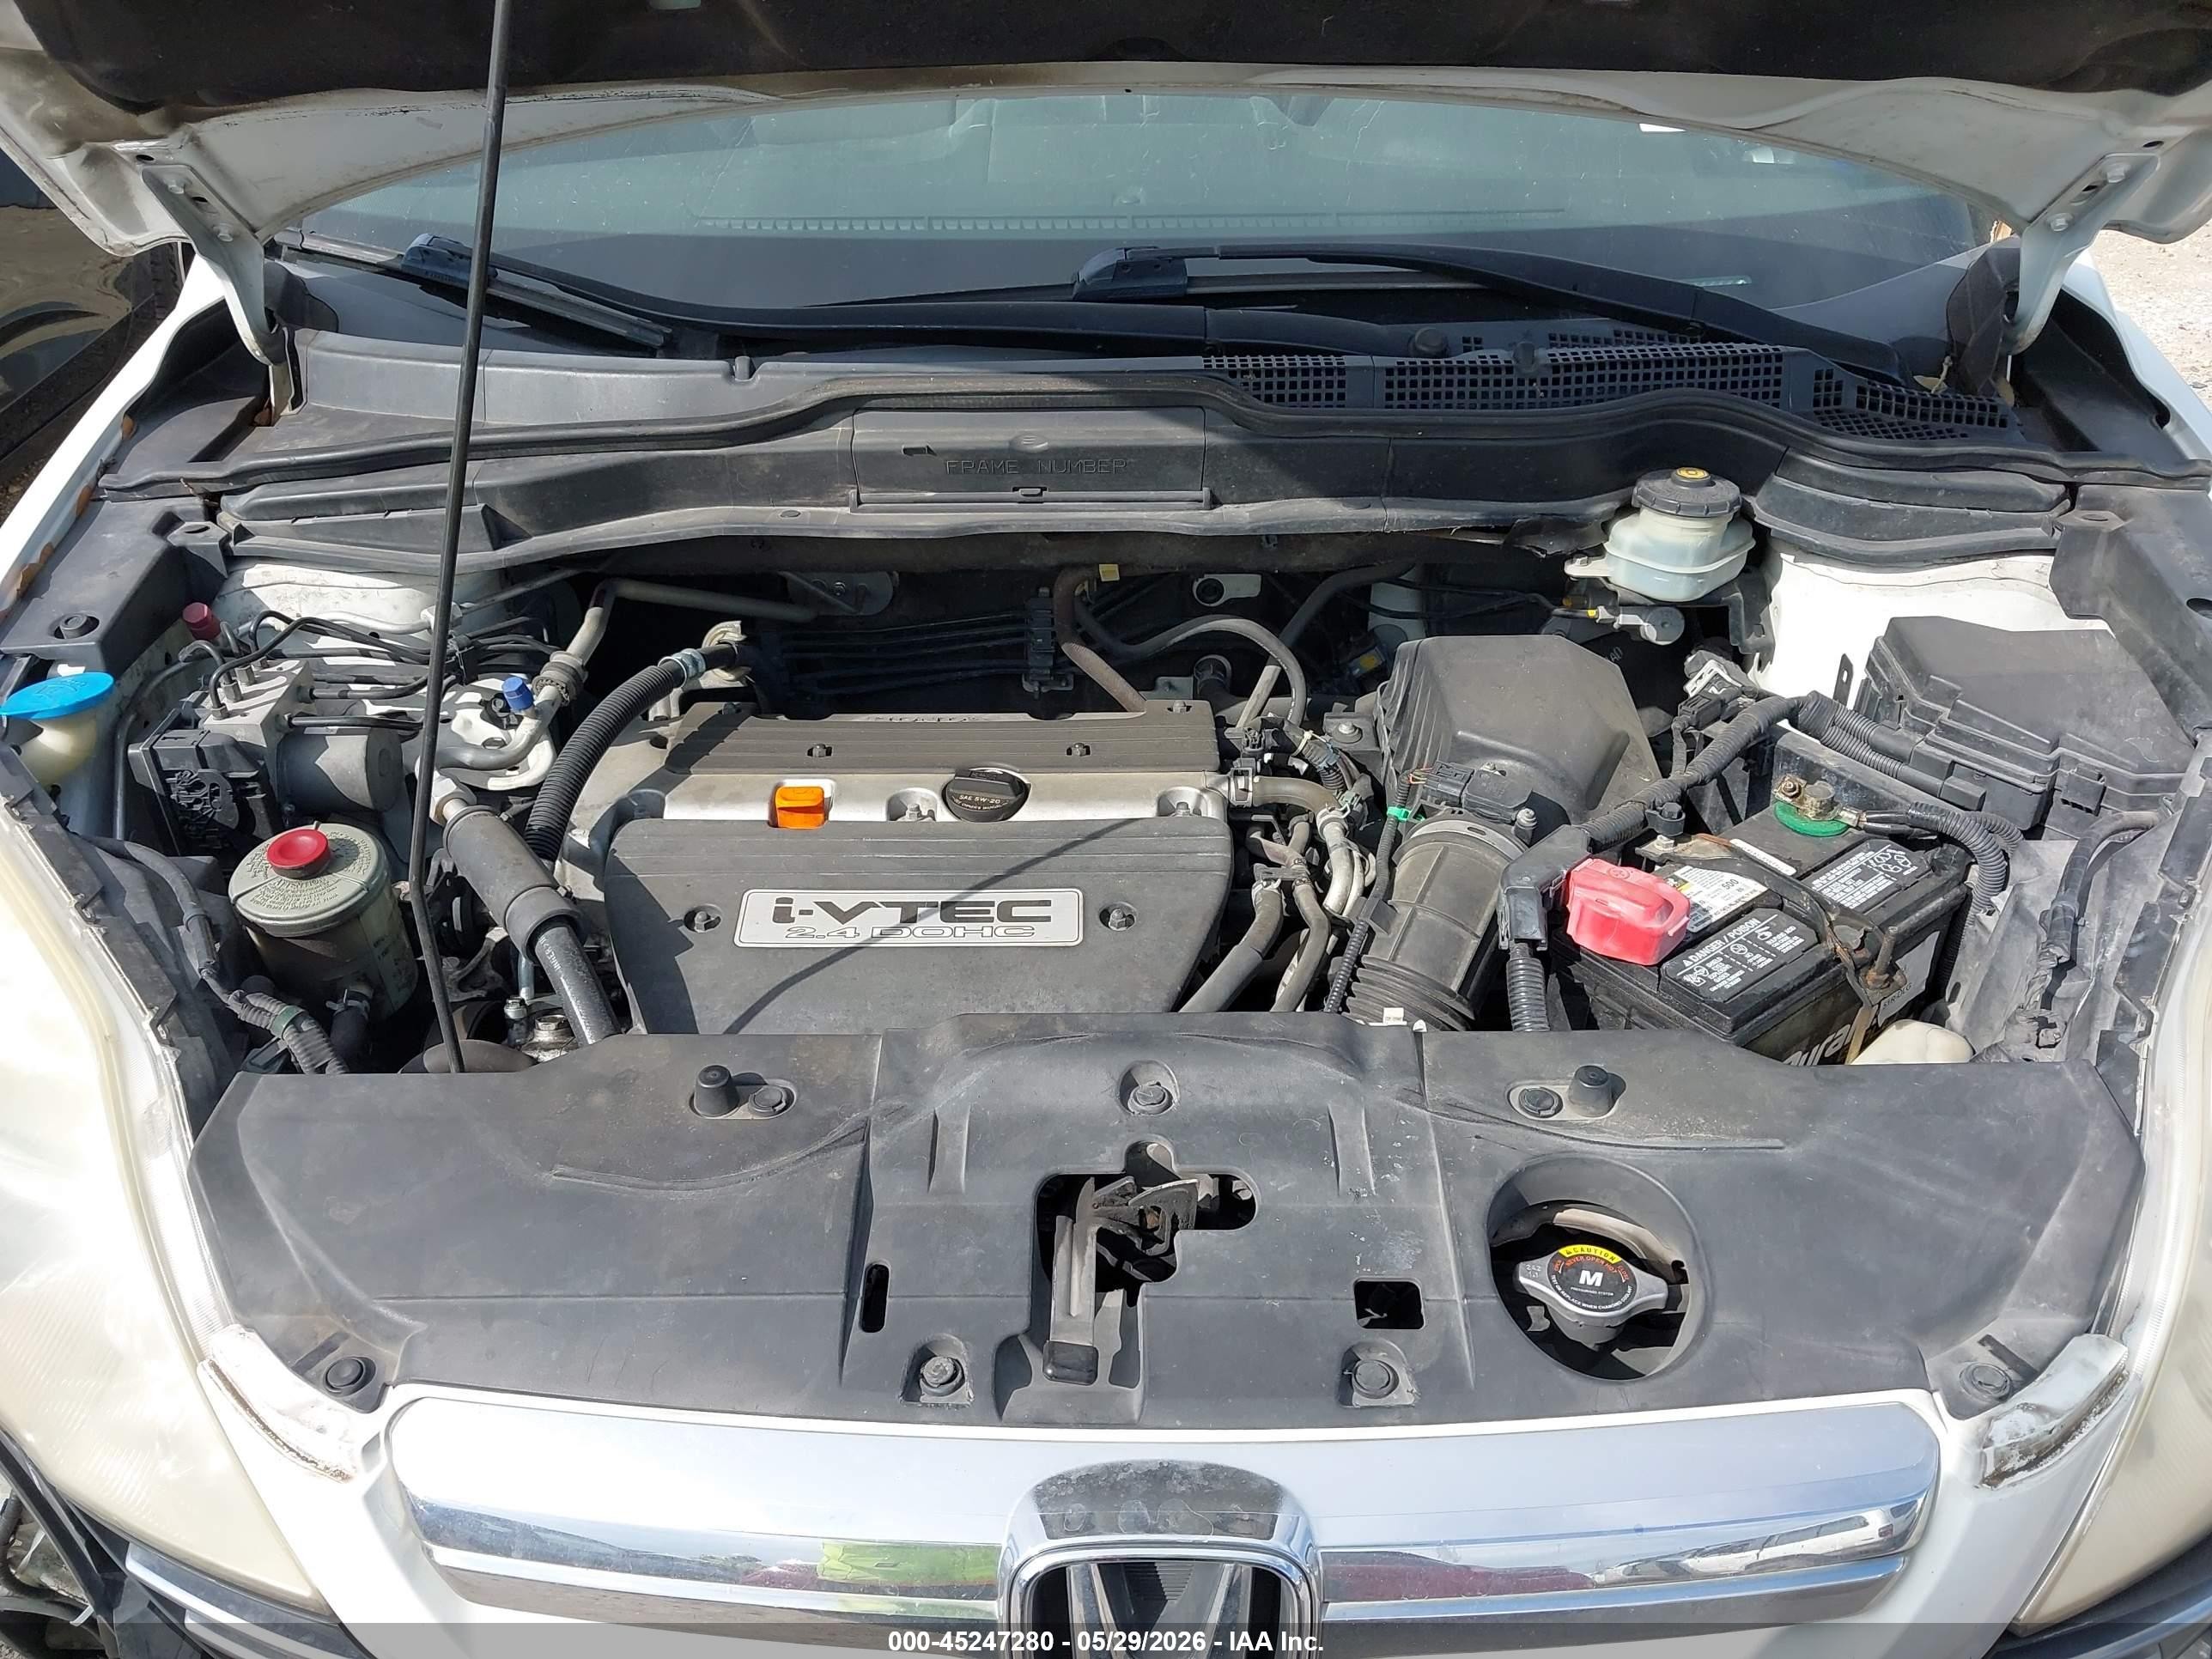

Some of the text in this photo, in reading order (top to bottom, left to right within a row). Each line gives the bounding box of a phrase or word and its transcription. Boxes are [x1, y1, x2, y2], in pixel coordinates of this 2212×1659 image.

[1722, 878, 1739, 890] 500
[772, 896, 1052, 925] i-VTEC
[785, 926, 1035, 939] 2.4 DOHC
[1688, 939, 1726, 963] DANGER
[1727, 917, 1761, 939] POISON
[1572, 1247, 1616, 1261] CAUTION
[1585, 1256, 1605, 1265] OPEN
[1579, 1270, 1604, 1287] M
[1560, 1290, 1581, 1305] REPLACE
